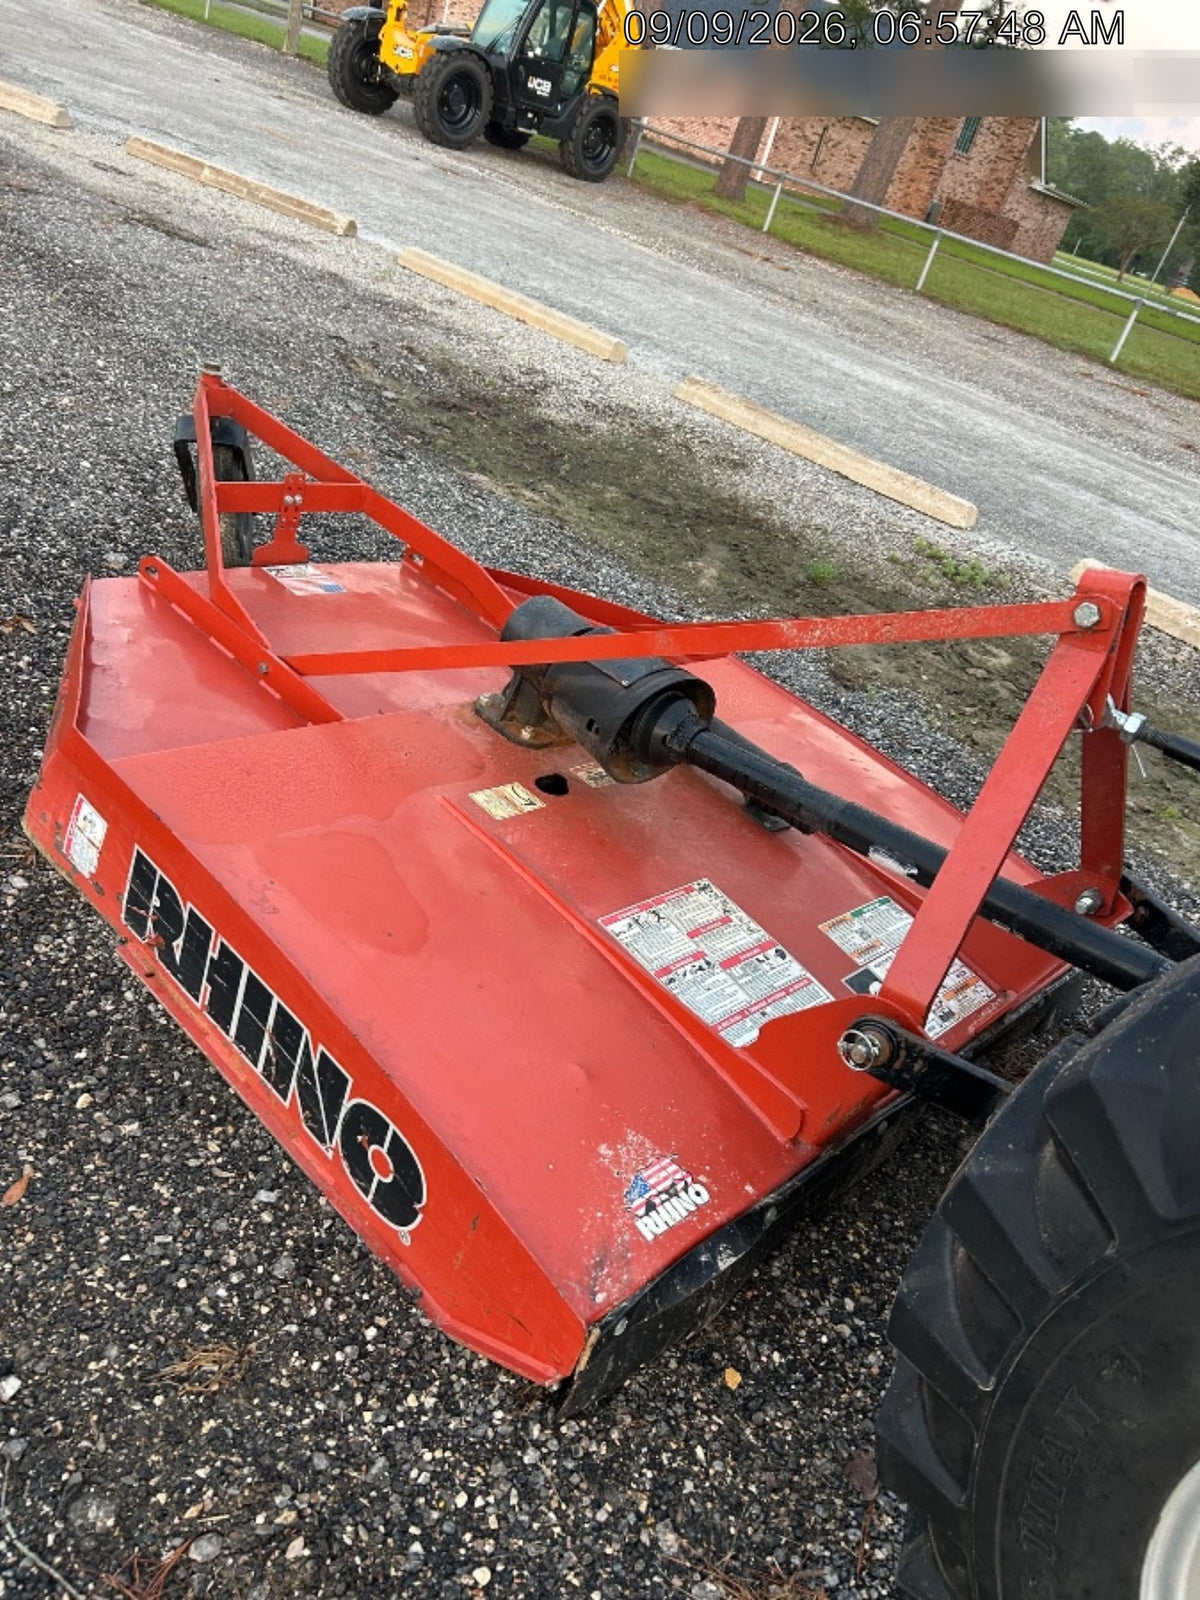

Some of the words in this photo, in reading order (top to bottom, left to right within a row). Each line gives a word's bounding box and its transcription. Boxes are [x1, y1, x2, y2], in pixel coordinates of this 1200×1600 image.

[393, 45, 413, 60] JCB
[528, 75, 552, 93] JCB
[122, 843, 427, 1231] RHINO
[635, 1183, 711, 1242] RHINO
[1016, 1386, 1100, 1565] TITAN
